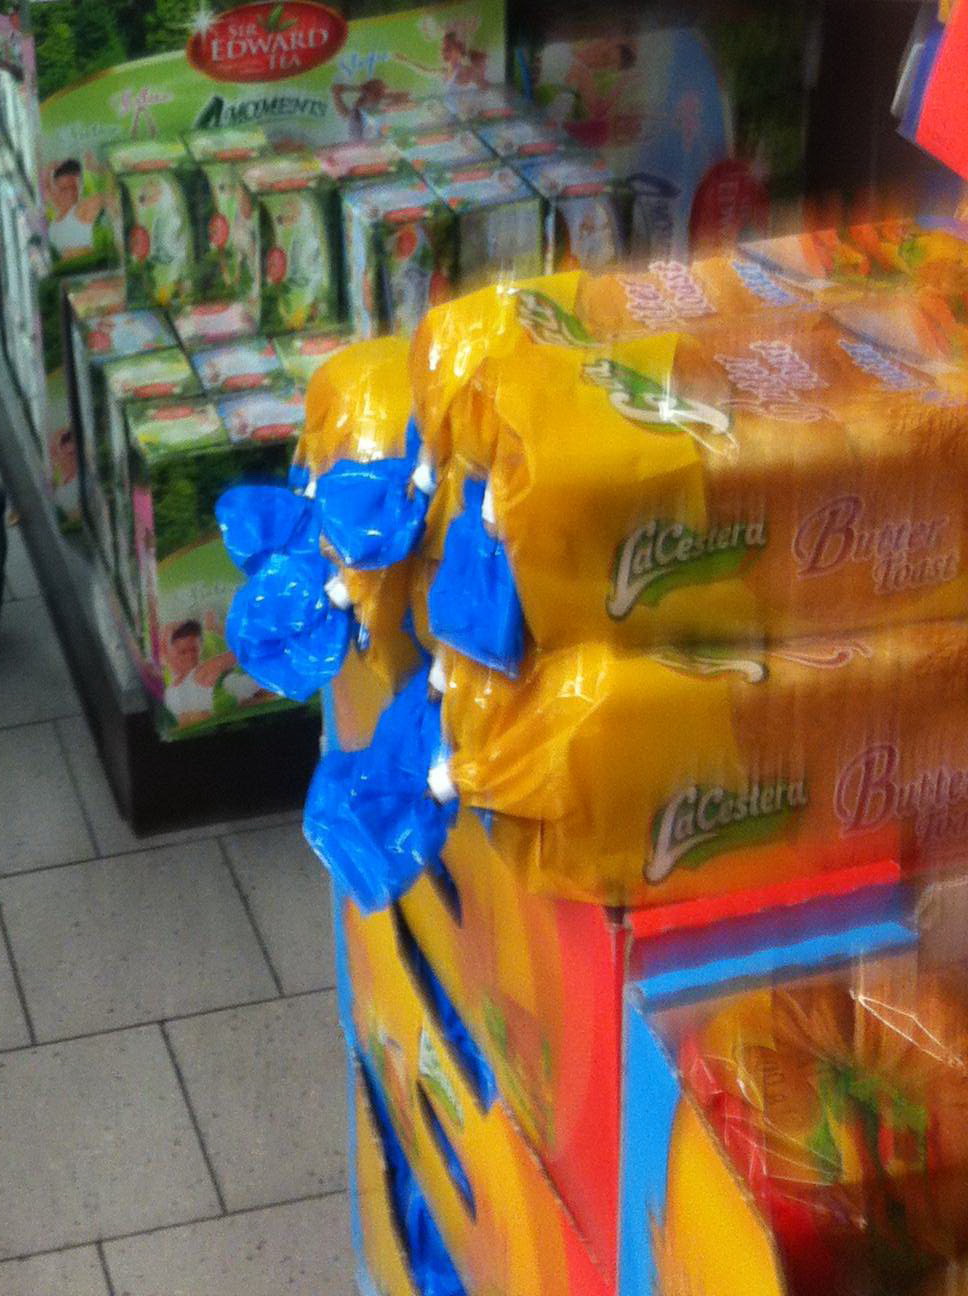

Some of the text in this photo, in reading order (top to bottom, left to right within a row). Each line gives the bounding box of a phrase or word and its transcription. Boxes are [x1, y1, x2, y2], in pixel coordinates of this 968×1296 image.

[228, 23, 257, 39] SIR
[210, 28, 329, 62] EDWARD
[269, 54, 302, 70] TEA
